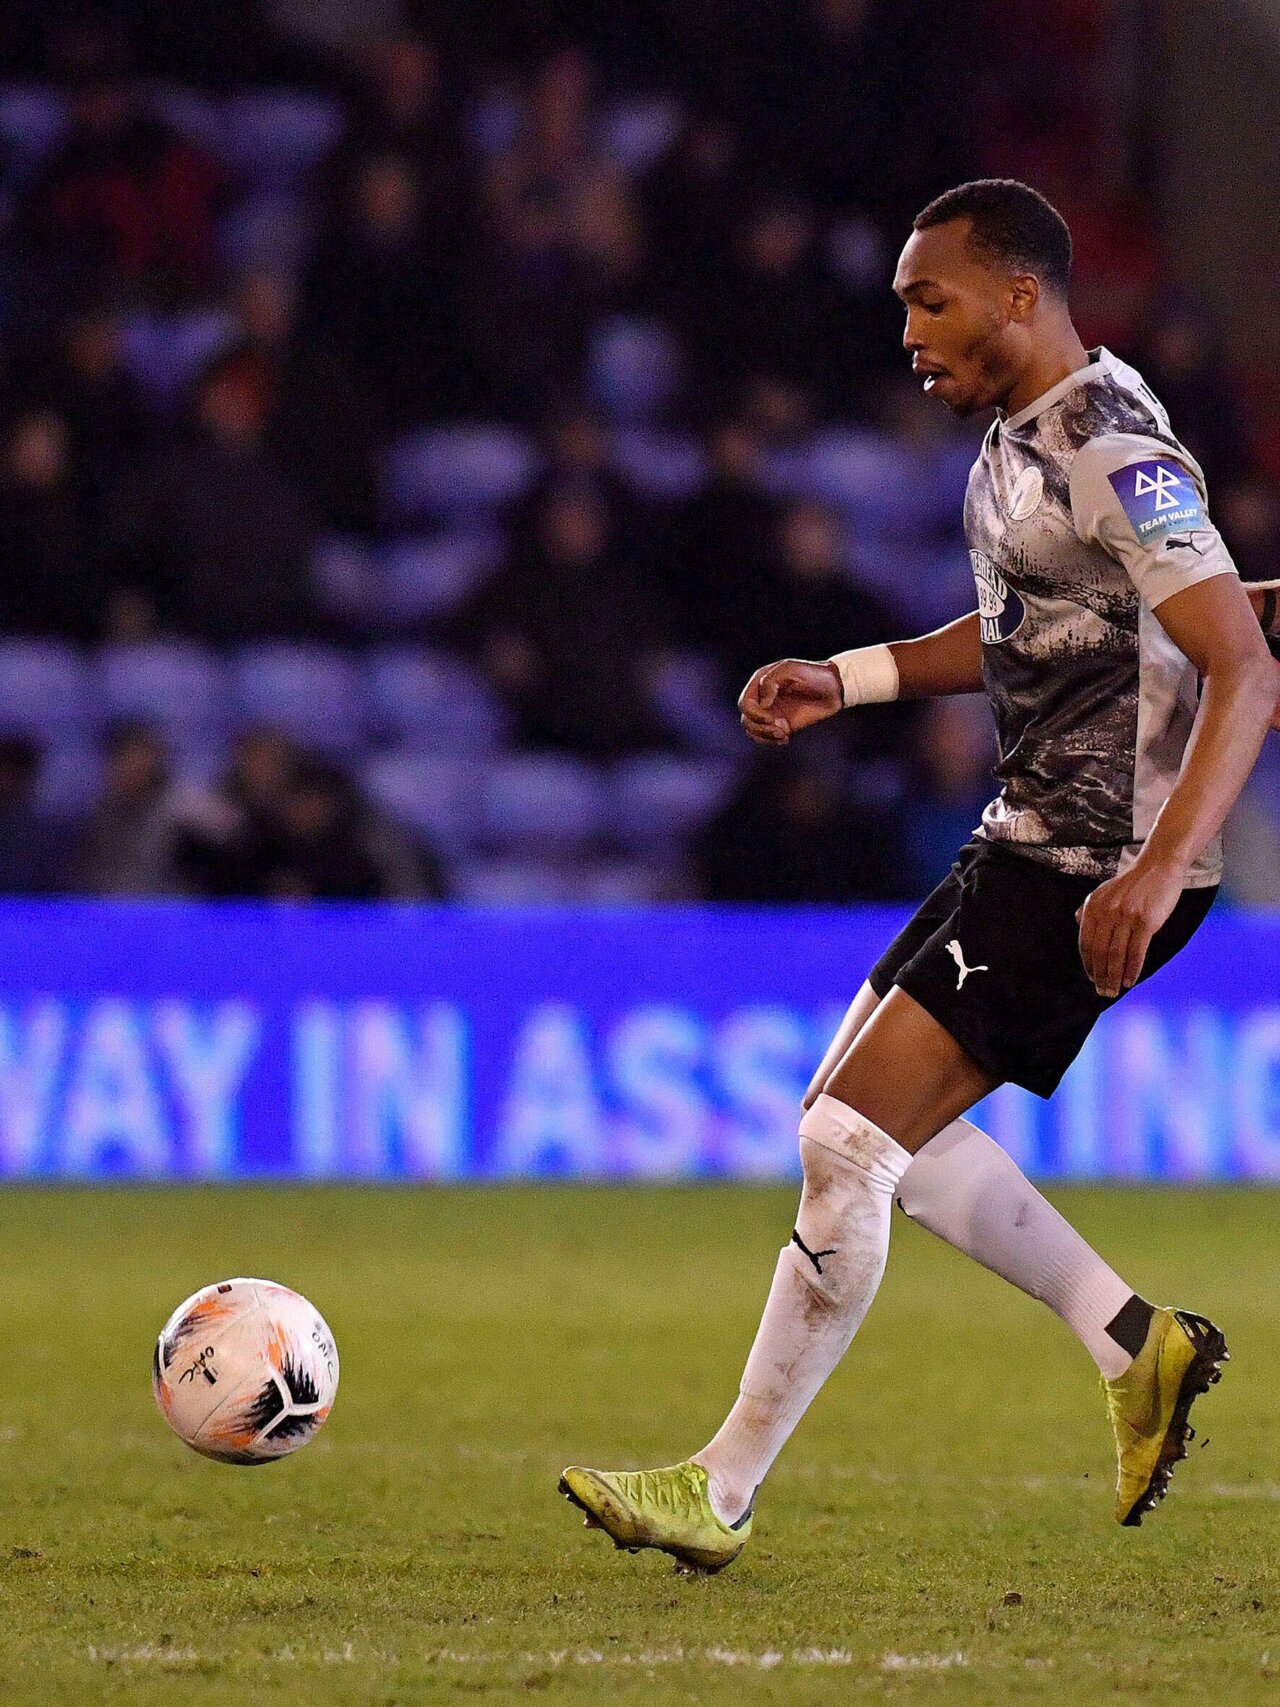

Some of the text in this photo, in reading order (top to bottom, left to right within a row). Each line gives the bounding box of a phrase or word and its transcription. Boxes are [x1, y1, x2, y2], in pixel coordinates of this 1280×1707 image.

[1139, 514, 1167, 533] TEAM
[1167, 508, 1198, 521] VALLEY
[288, 1000, 471, 1181] IN
